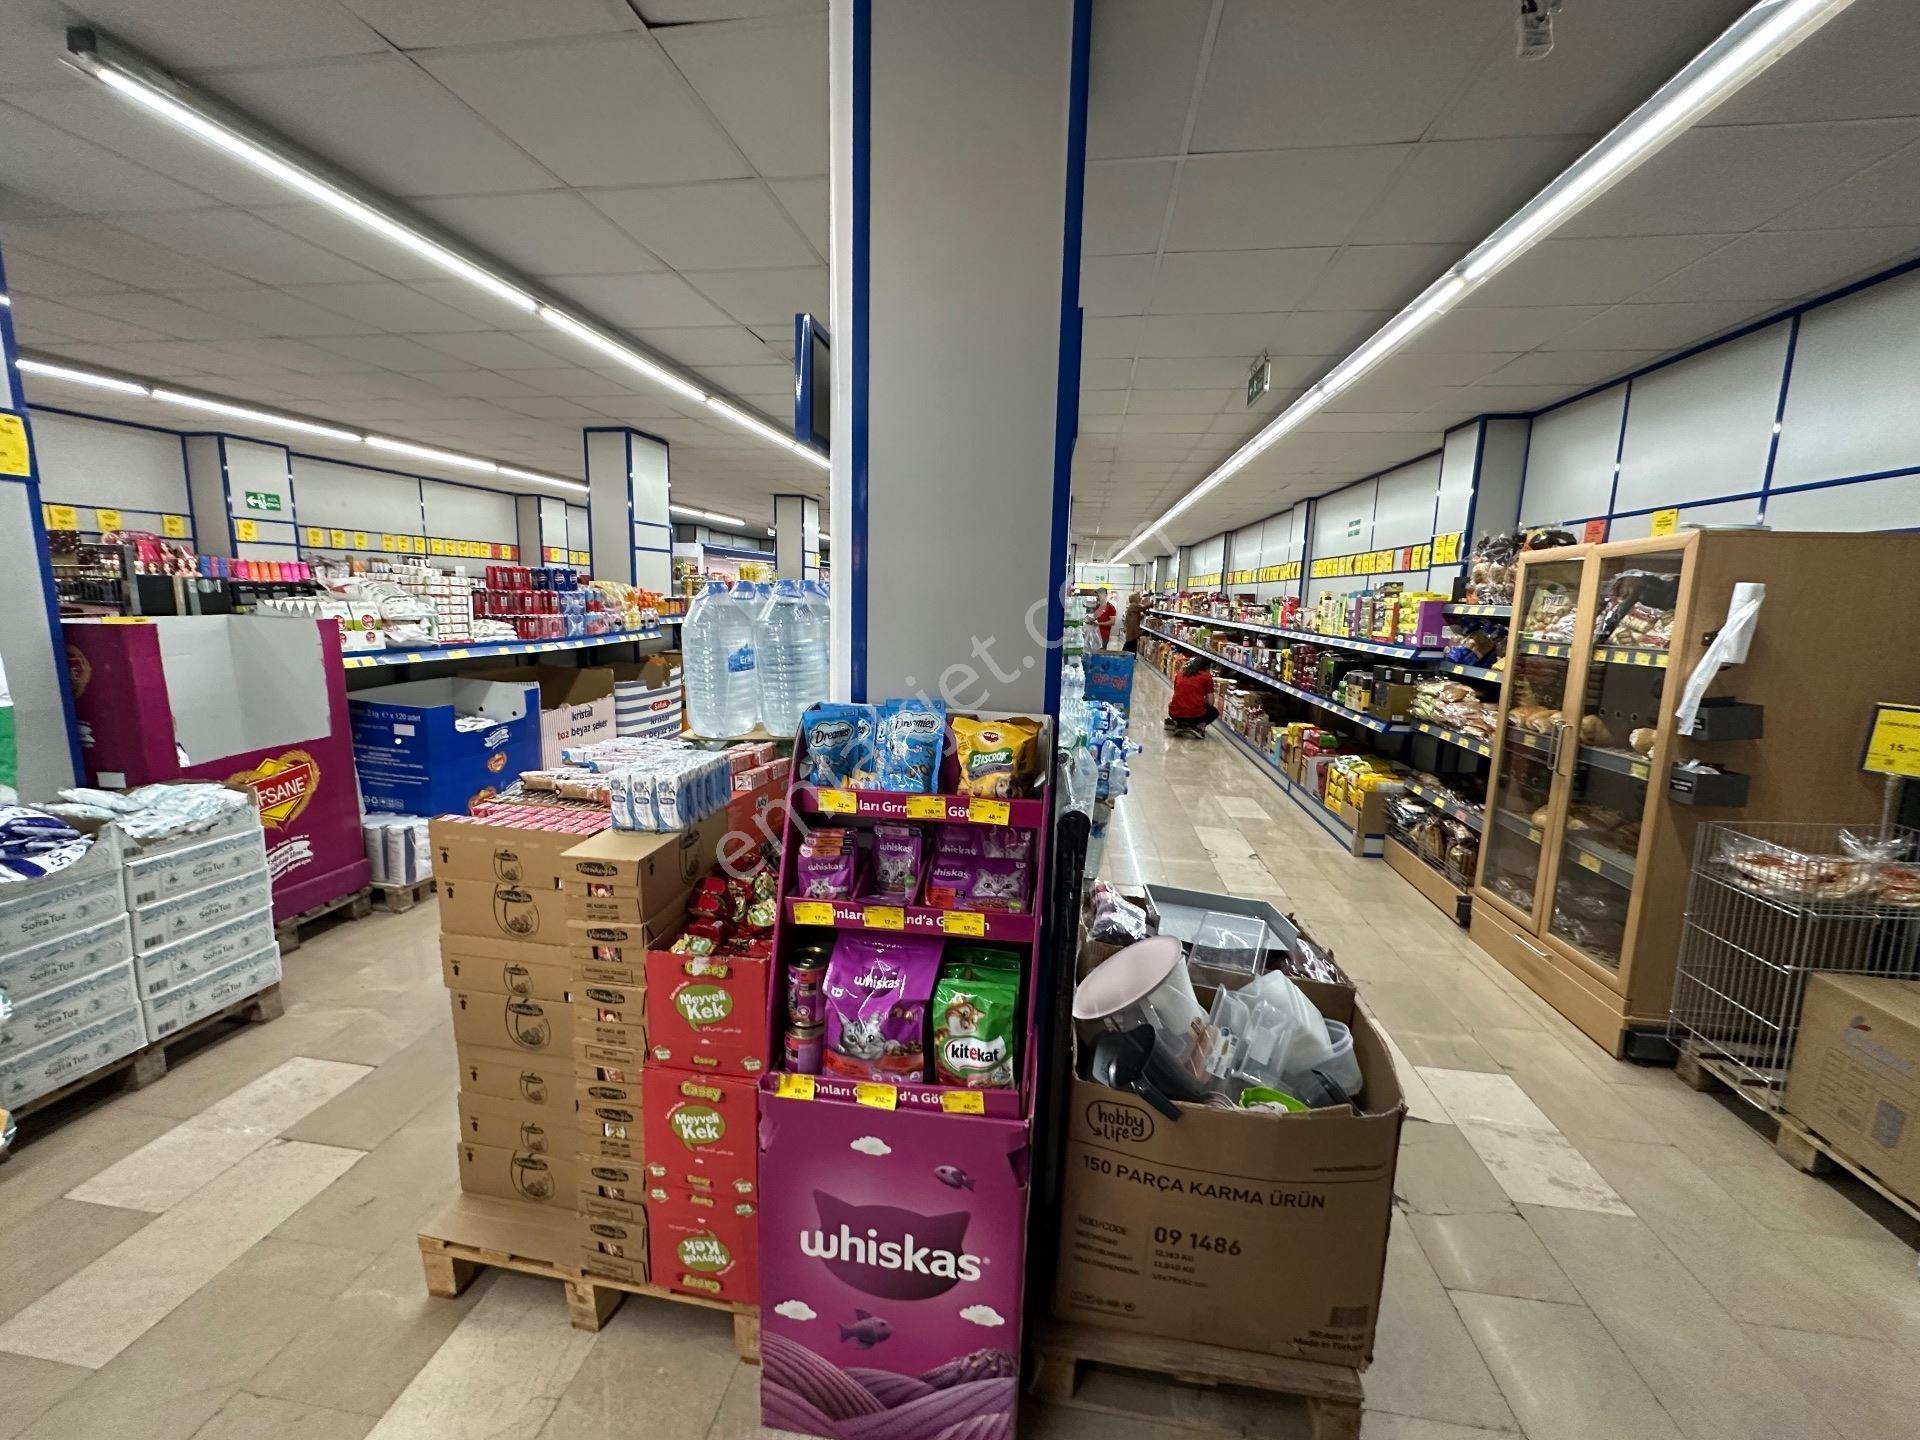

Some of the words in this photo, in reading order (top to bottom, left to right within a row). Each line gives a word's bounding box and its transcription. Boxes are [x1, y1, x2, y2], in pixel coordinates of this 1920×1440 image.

[572, 706, 593, 721] kristal
[895, 717, 936, 731] Dreamies
[557, 731, 570, 741] toz
[571, 725, 591, 738] beyaz
[815, 726, 851, 744] Dreamies
[258, 776, 306, 807] FSANE
[859, 799, 879, 812] ları
[880, 842, 913, 854] whiskas
[808, 862, 845, 871] whiskas
[685, 960, 728, 978] Csey
[854, 976, 901, 989] whiskas
[679, 989, 726, 1005] Meyveli
[687, 1002, 726, 1020] Kek
[951, 1043, 999, 1063] kitekat
[681, 1081, 721, 1102] Casey
[675, 1112, 719, 1126] Meyveli
[1098, 1103, 1144, 1137] hobby
[681, 1124, 720, 1139] Kek
[1083, 1155, 1112, 1174] 150
[1116, 1165, 1185, 1196] PARÇA
[1189, 1181, 1264, 1206] KARMA
[1271, 1189, 1326, 1209] ÜRÜN
[683, 1240, 721, 1255] Kek
[1154, 1226, 1183, 1245] 09
[1189, 1232, 1242, 1256] 1486
[682, 1254, 727, 1265] Meyveli
[799, 1223, 983, 1283] whiskas
